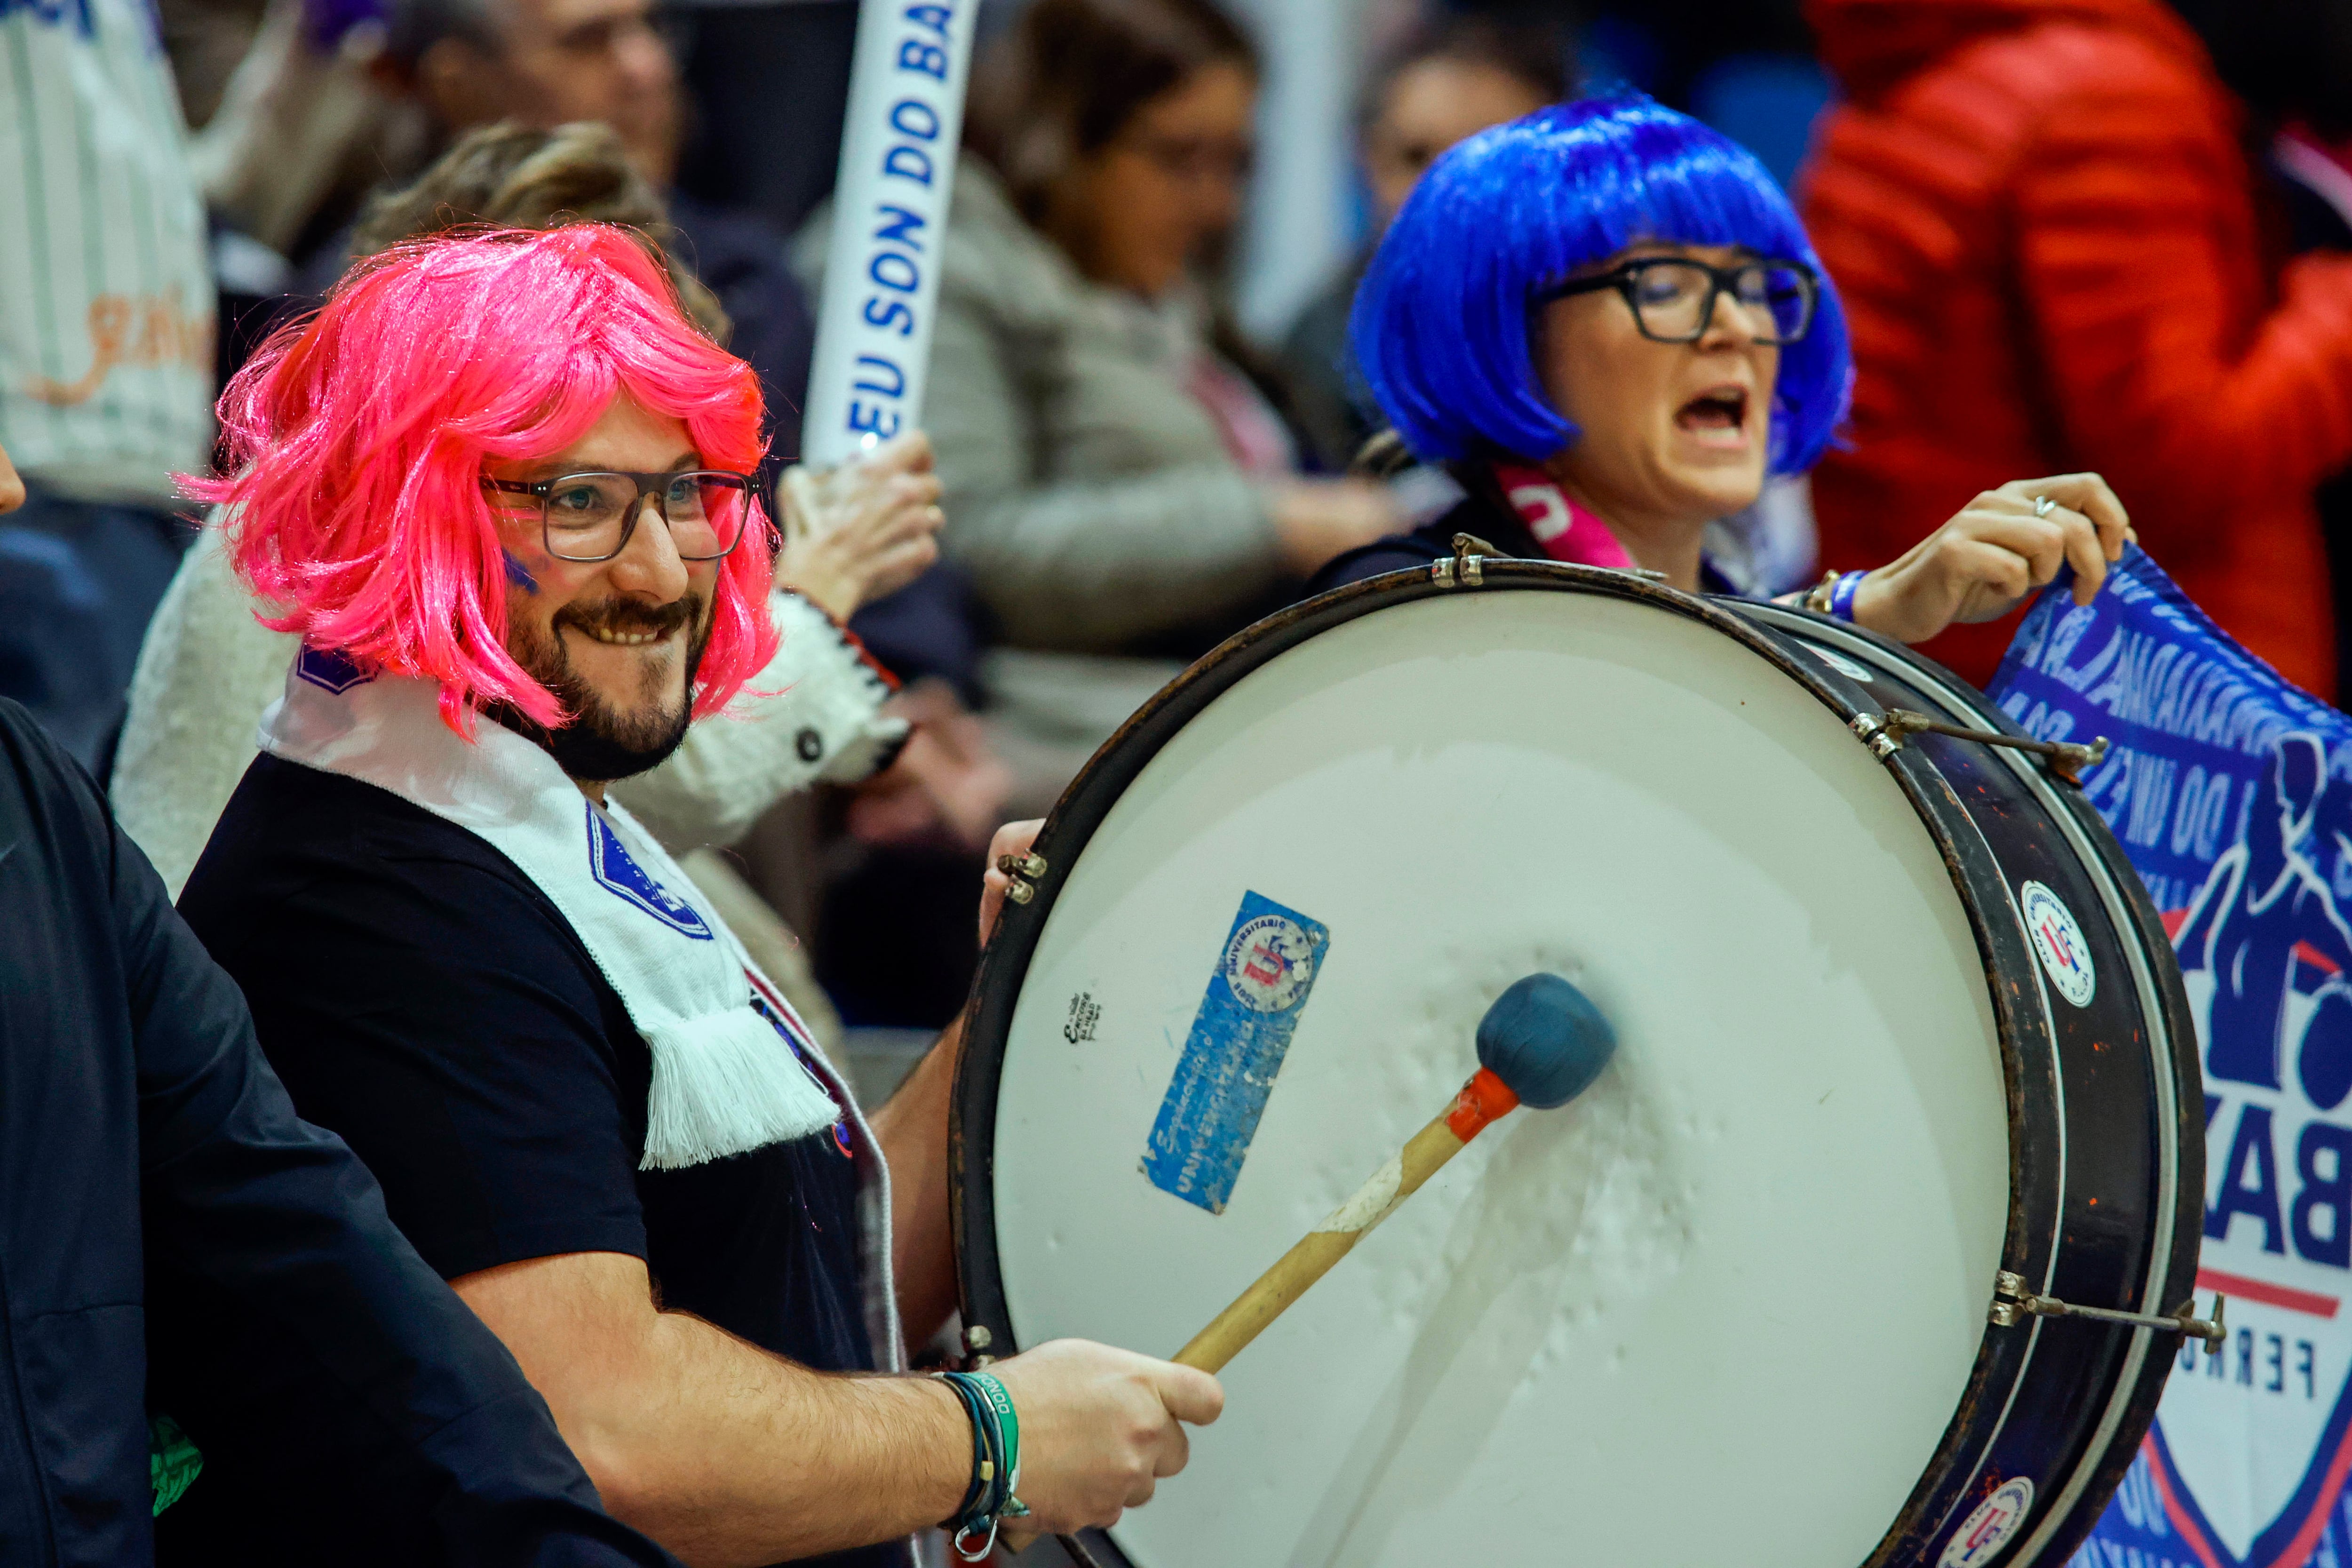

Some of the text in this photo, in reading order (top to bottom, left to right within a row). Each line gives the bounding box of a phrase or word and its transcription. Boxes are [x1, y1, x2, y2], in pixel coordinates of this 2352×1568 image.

[882, 99, 941, 185] DO
[862, 204, 927, 337] SON
[847, 356, 906, 440] EU
[2029, 892, 2072, 930] UNIVERSITARIO
